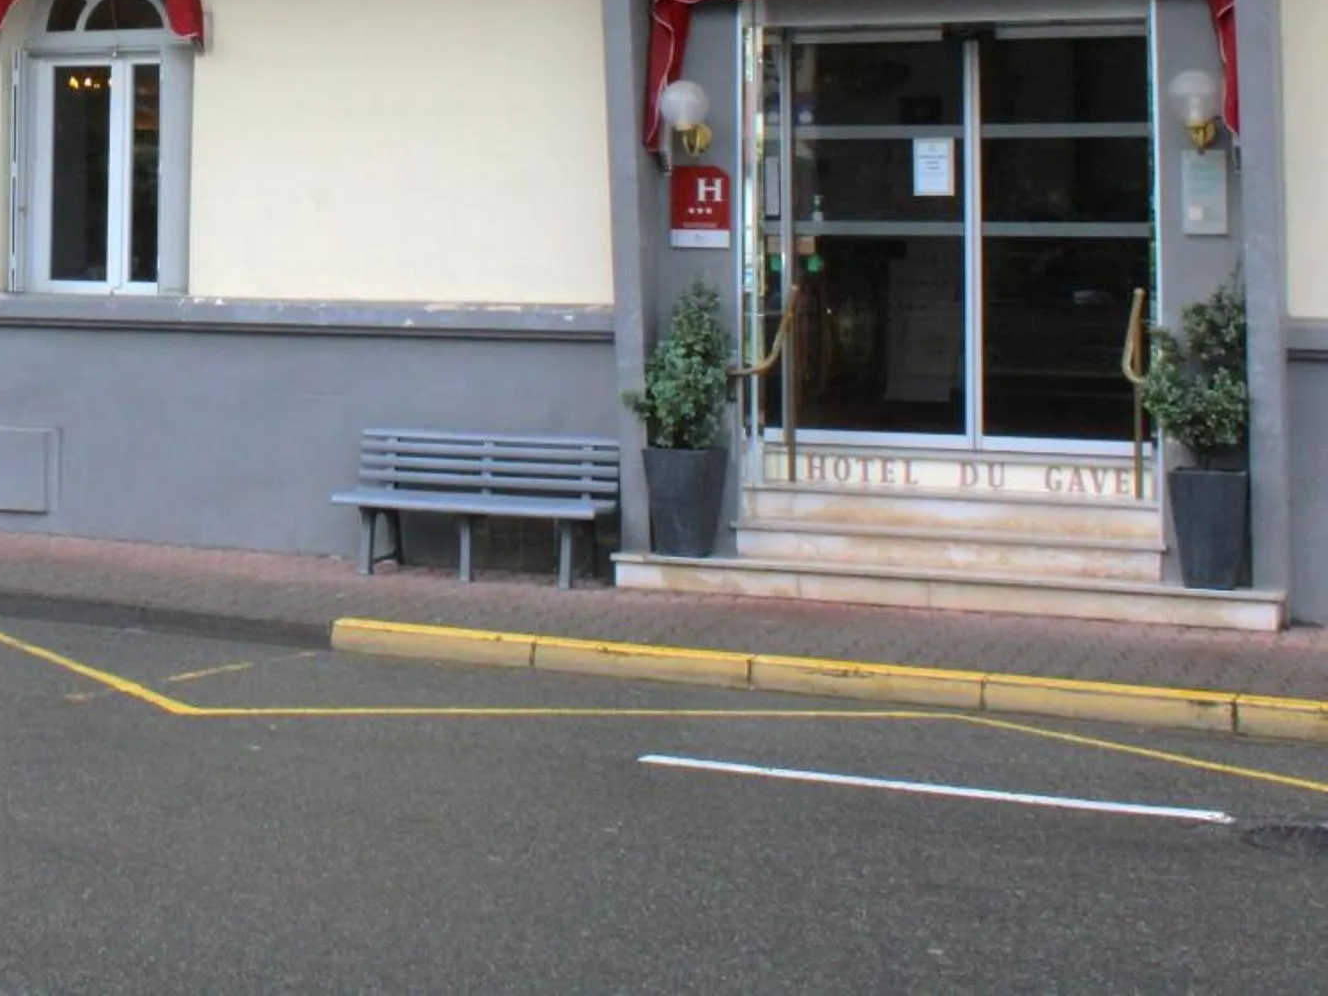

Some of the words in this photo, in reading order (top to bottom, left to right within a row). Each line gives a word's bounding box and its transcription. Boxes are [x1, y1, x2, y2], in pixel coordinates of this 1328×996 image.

[697, 178, 723, 202] H
[806, 453, 919, 486] HOTEL
[959, 460, 1008, 490] DU
[1044, 465, 1133, 495] GAVE
